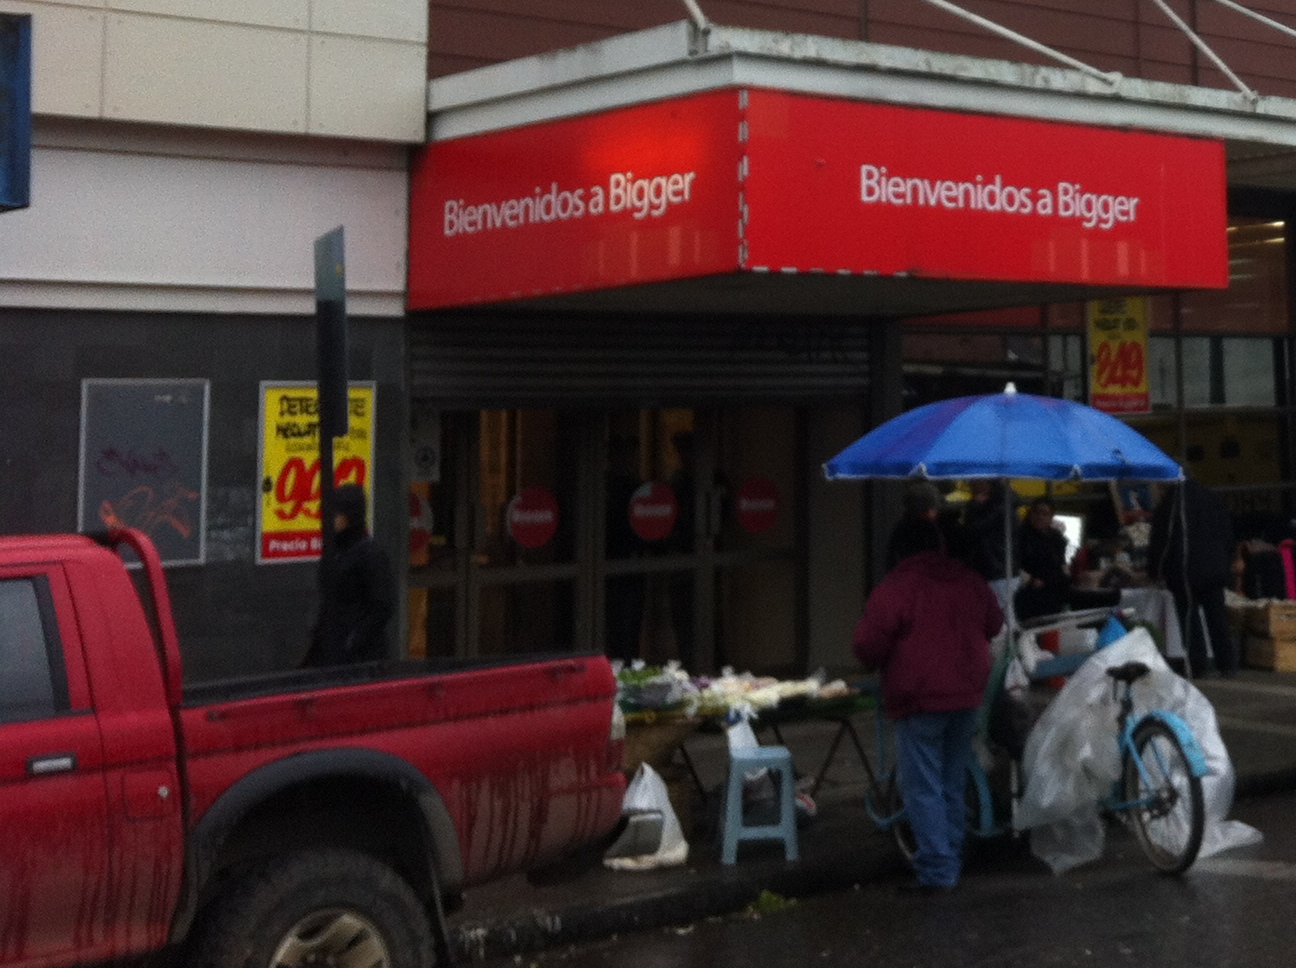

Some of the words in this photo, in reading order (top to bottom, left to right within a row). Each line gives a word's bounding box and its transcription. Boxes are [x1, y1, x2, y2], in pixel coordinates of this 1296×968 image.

[443, 182, 585, 237] Bienvenidos
[588, 185, 605, 216] a
[608, 171, 696, 220] Bigger
[859, 163, 1034, 214] Bienvenidos
[1036, 188, 1054, 216] a
[1057, 181, 1139, 230] Bigger
